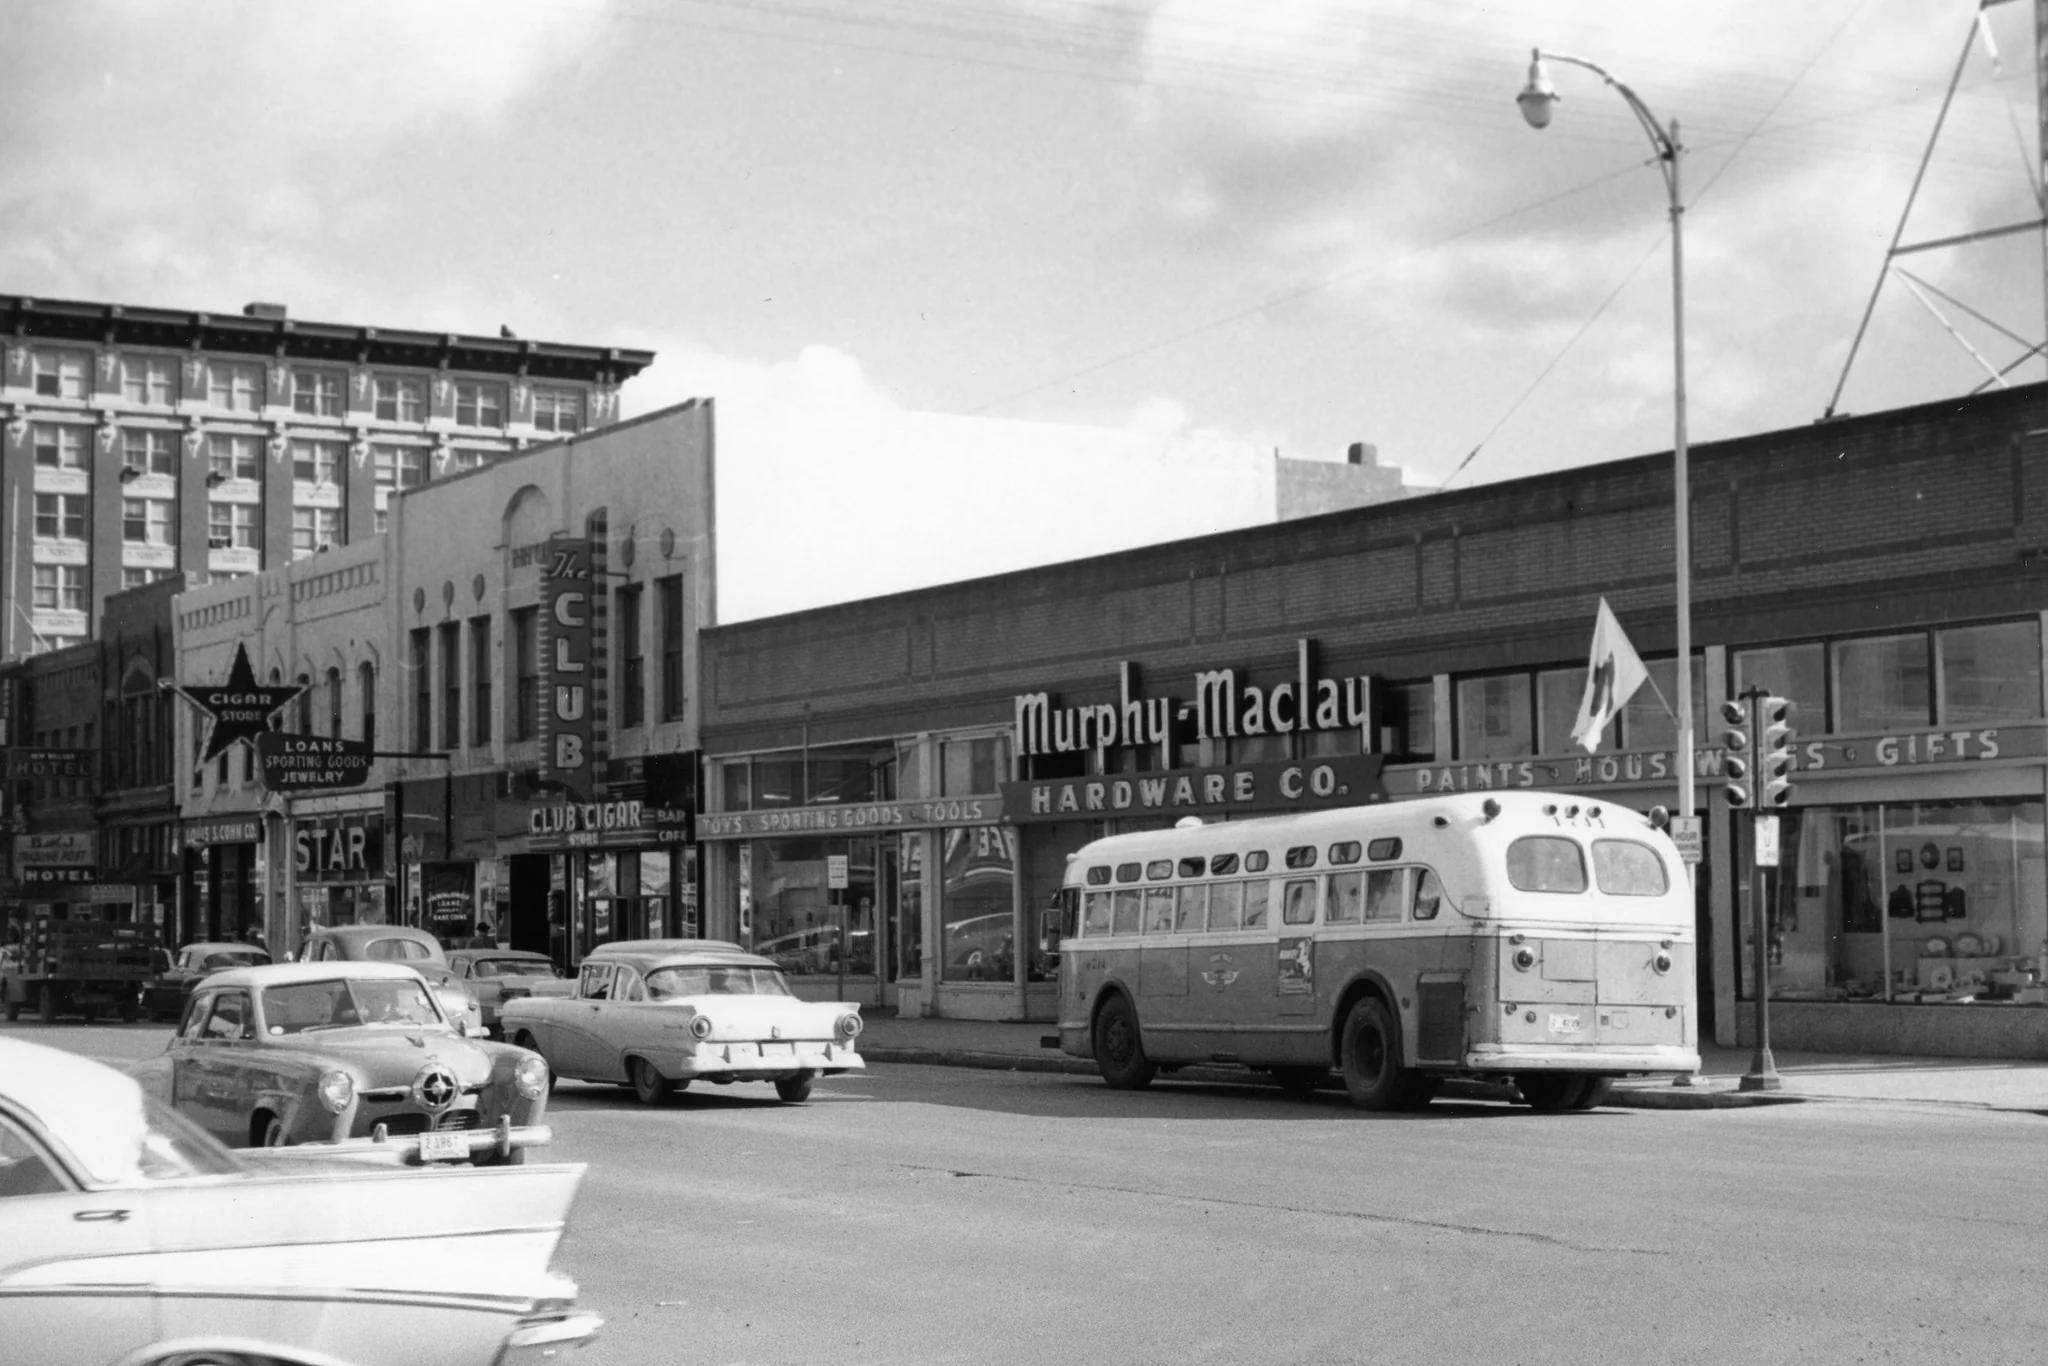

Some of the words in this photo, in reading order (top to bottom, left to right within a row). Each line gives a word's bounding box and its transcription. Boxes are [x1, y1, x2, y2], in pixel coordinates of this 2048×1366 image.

[551, 551, 588, 579] The
[554, 591, 585, 770] CLUB
[208, 693, 272, 705] CIGAR
[221, 709, 262, 722] STORE
[284, 741, 344, 753] LOANS
[16, 761, 90, 776] HOTEL
[265, 755, 322, 768] SPORTING
[327, 755, 367, 768] GOODS
[1416, 762, 1534, 791] PAINTS
[1876, 730, 2000, 766] GIFTS
[281, 771, 344, 784] JEWELRY
[1030, 771, 1256, 815] HARDWARE
[1278, 764, 1349, 799] CO.
[530, 804, 576, 833] CLUB
[584, 800, 641, 830] CIGAR
[760, 809, 837, 831] SPORTING
[843, 805, 903, 827] GOODS
[923, 802, 983, 822] TOOLS
[296, 826, 365, 872] STAR
[25, 869, 95, 881] HOTEL
